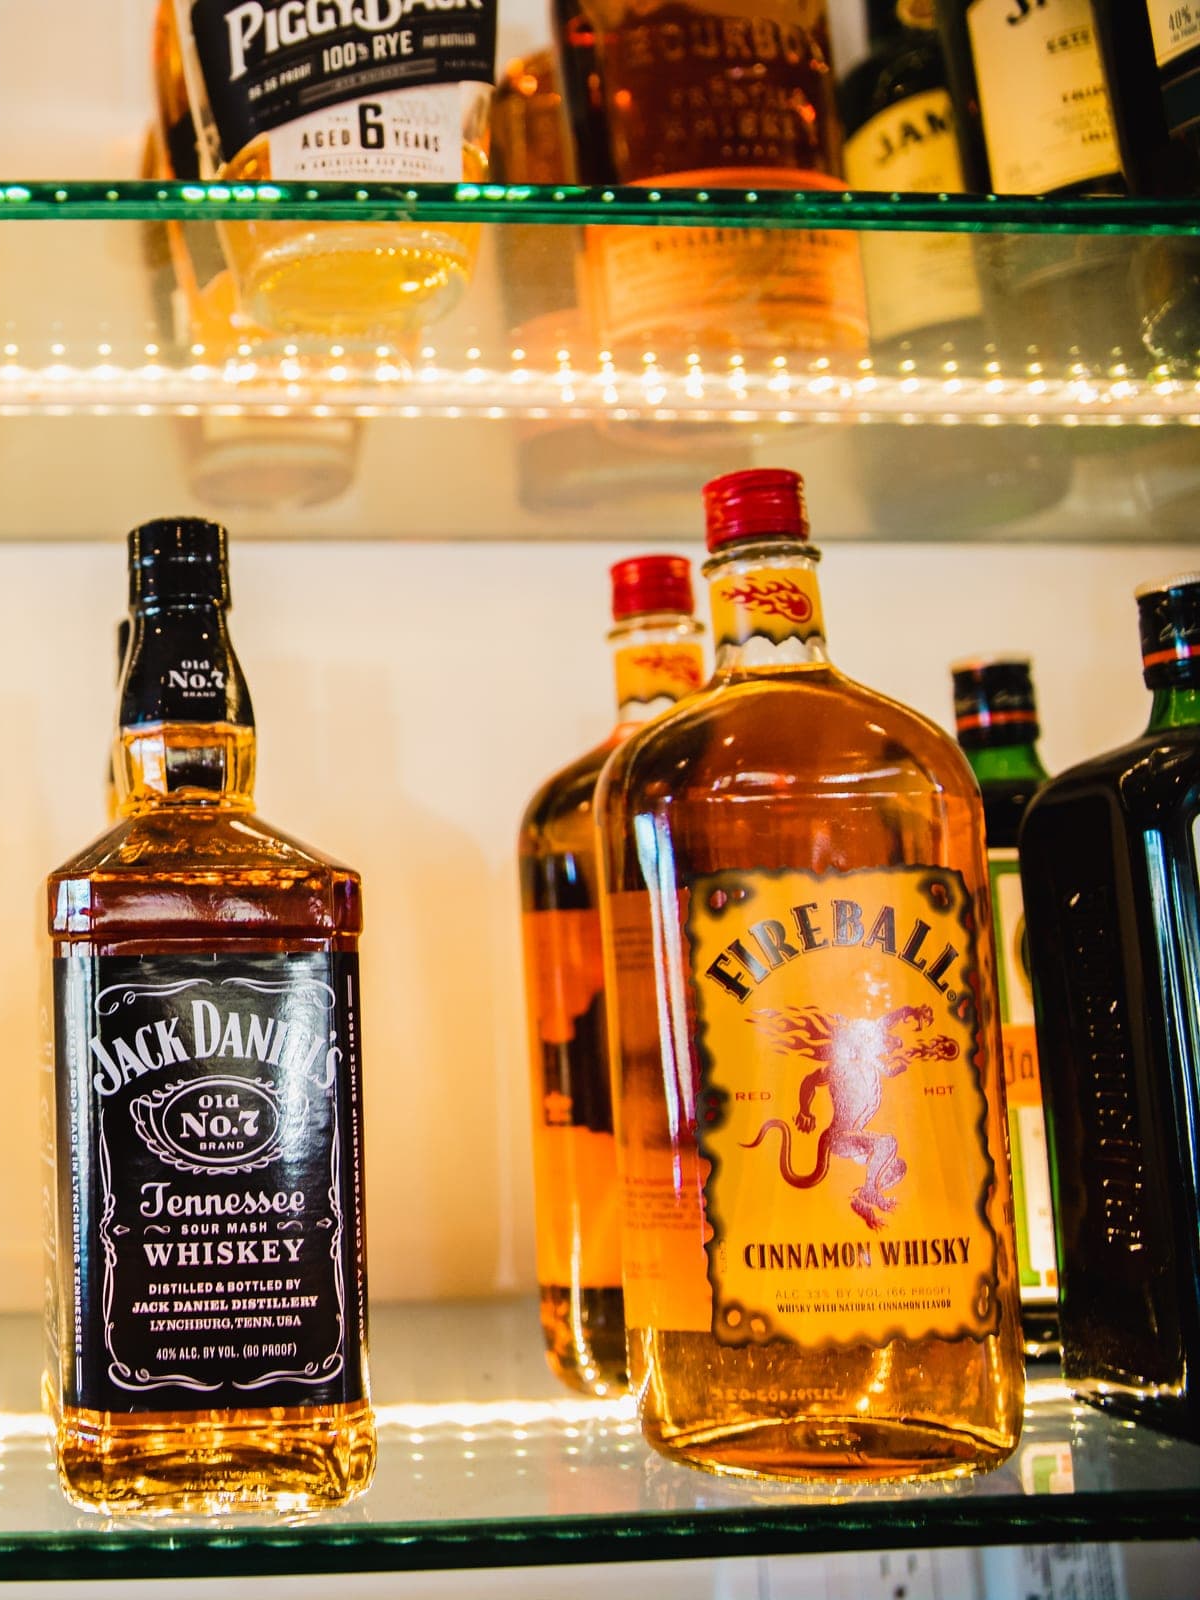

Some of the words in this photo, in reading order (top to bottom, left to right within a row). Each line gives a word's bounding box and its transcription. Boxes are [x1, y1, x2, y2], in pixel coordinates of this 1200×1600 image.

[223, 0, 484, 82] PIGGY
[372, 29, 414, 60] RYE
[359, 103, 385, 150] 6
[302, 128, 351, 150] AGED
[395, 130, 440, 152] YEARS
[181, 659, 210, 670] Old
[168, 668, 225, 689] No.7
[706, 899, 959, 1003] FIREBALL
[88, 1017, 191, 1096] JACK
[191, 999, 344, 1090] DANIL'S
[735, 1090, 772, 1101] RED
[924, 1085, 955, 1096] HOT
[199, 1094, 240, 1109] Old
[180, 1109, 260, 1138] No.7
[199, 1140, 244, 1151] BRAND
[139, 1182, 306, 1218] Tennessee
[72, 1175, 80, 1264] LYNCHBURG
[181, 1223, 220, 1236] SOUR
[227, 1222, 268, 1234] MASH
[143, 1239, 306, 1267] WHISKEY
[745, 1242, 872, 1270] CINNAMON
[880, 1237, 971, 1266] WHISKY
[149, 1281, 213, 1295] DISTILLED
[215, 1280, 225, 1293] &
[228, 1279, 283, 1293] BOTTLED
[286, 1278, 302, 1291] BY
[836, 1289, 851, 1299] BY
[73, 1266, 82, 1354] TENNESSEE
[132, 1301, 170, 1315] JACK
[174, 1299, 229, 1313] DANIEL
[232, 1295, 320, 1311] DISTILLERY
[777, 1303, 811, 1313] WHISKY
[814, 1303, 837, 1313] WITH
[839, 1302, 876, 1312] NATURAL
[879, 1301, 921, 1312] CINNAMON
[922, 1299, 951, 1309] FLAVOR
[276, 1315, 302, 1328] USA
[156, 1347, 177, 1361] 40%
[203, 1345, 216, 1359] BY
[218, 1345, 240, 1359] VOL.
[262, 1341, 298, 1357] PROOF)
